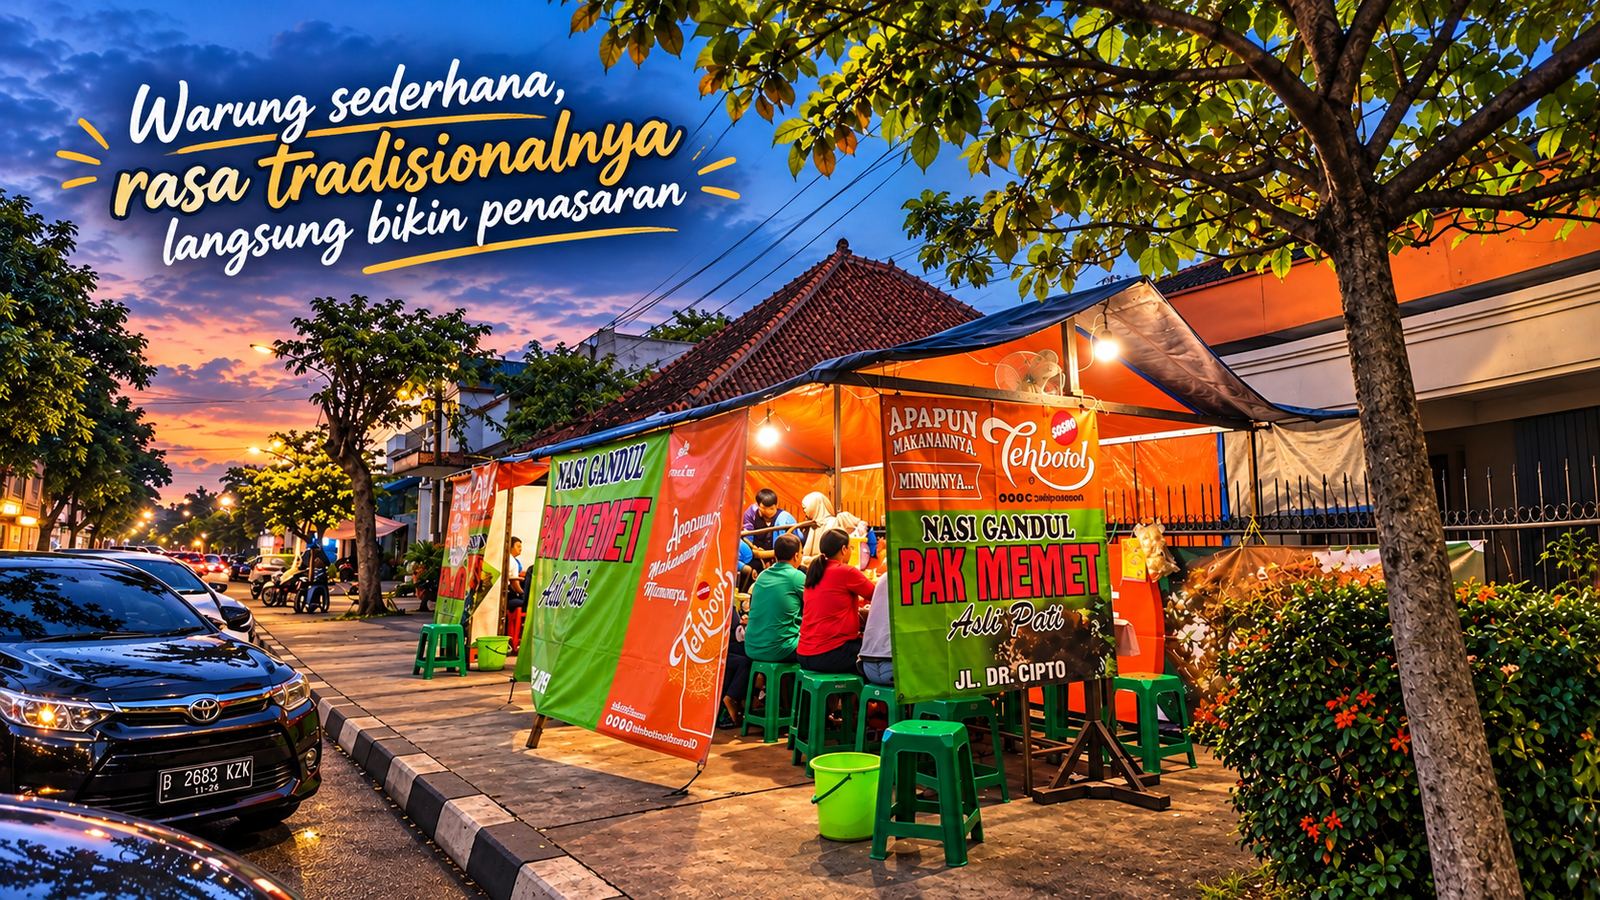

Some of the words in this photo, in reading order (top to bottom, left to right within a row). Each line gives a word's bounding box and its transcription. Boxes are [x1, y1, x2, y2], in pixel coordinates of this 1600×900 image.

[889, 406, 977, 438] APAPUN
[1051, 417, 1076, 439] SOSRO
[555, 456, 588, 492] NASI
[588, 442, 647, 487] GANDUL
[982, 417, 1095, 491] Tehbotol
[899, 472, 974, 490] MINUMNYA...
[538, 505, 573, 560] PAK
[563, 496, 653, 563] MEMET
[921, 513, 978, 543] NASI
[982, 513, 1075, 541] GANDUL
[899, 547, 967, 606] PAK
[976, 542, 1101, 602] MEMET
[946, 602, 1003, 641] Asli
[1009, 600, 1065, 637] Pati
[955, 670, 981, 690] JL.
[987, 667, 1014, 686] DR.
[1018, 660, 1066, 683] CIPTO
[163, 774, 172, 791] B
[184, 766, 218, 787] 2683
[226, 760, 250, 780] KZK
[195, 783, 219, 794] 11-26
